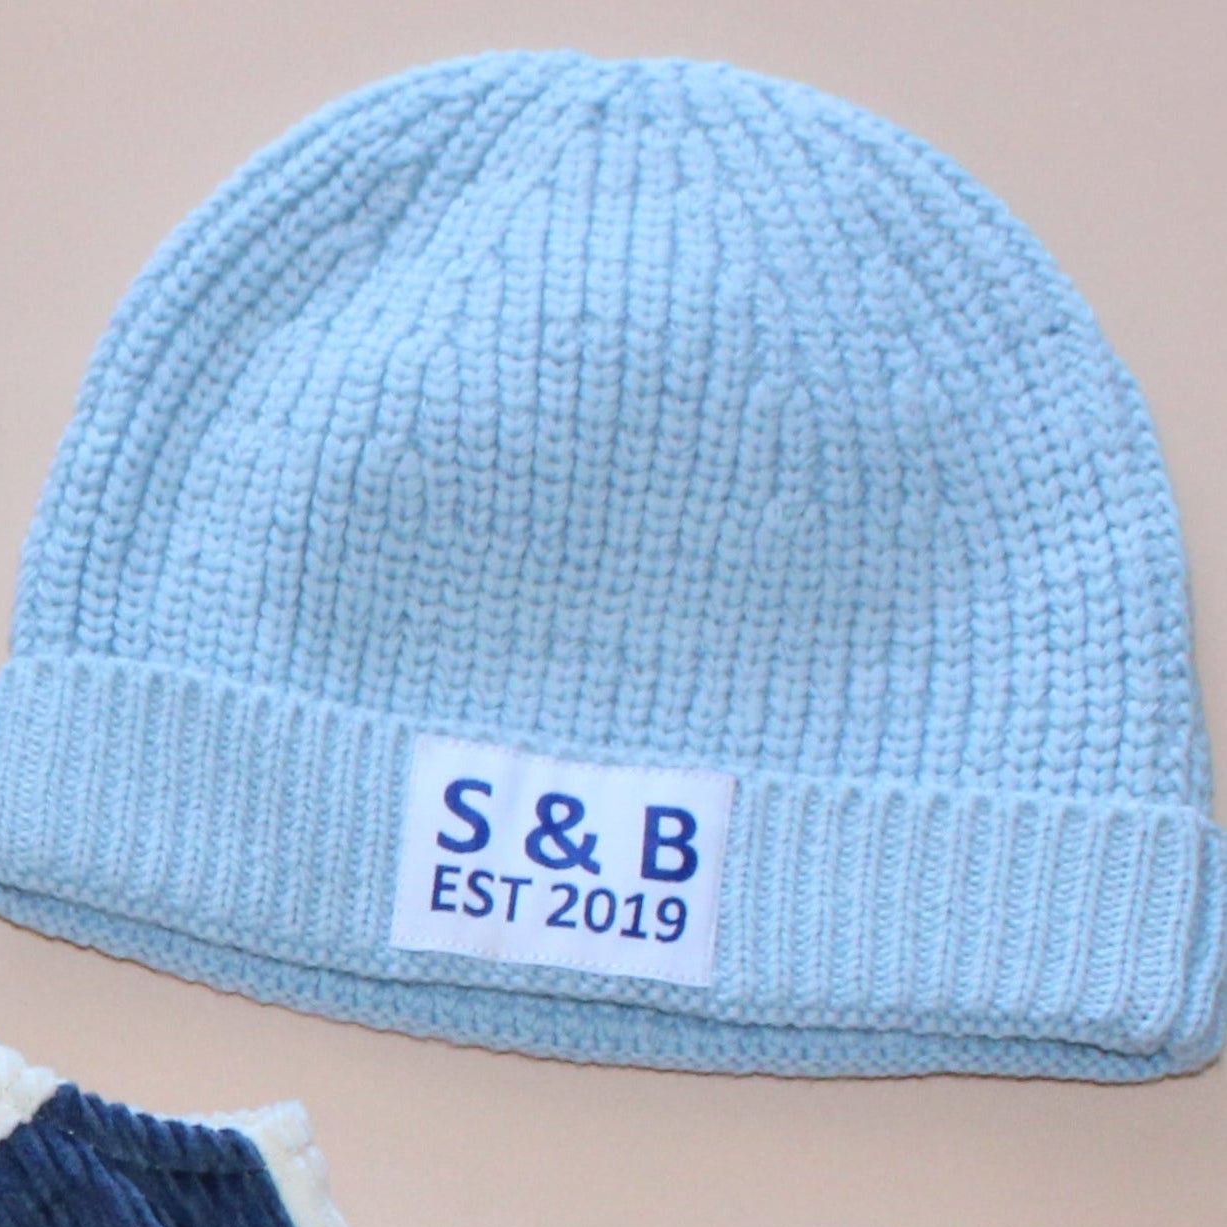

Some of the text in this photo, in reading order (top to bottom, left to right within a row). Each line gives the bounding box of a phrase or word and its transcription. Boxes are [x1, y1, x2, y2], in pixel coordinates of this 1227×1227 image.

[436, 777, 700, 884] S & B
[429, 863, 689, 944] EST 2019
